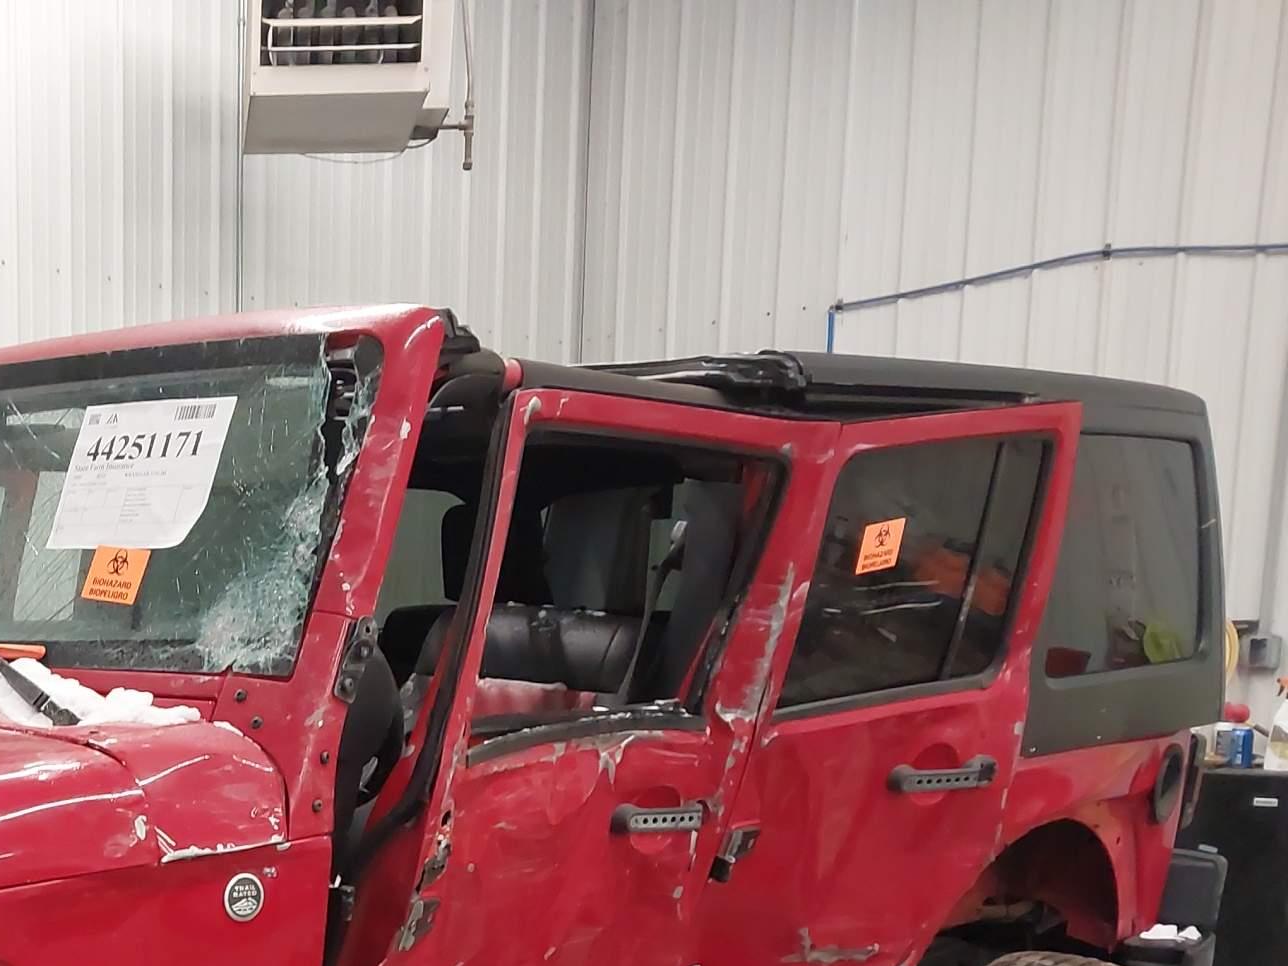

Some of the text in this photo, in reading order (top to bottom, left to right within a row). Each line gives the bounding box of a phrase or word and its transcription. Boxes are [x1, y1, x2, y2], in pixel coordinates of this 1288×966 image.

[87, 430, 204, 462] 44251171
[92, 577, 132, 590] BIOHAZARD
[89, 587, 129, 601] BIOPELIGRO
[232, 890, 258, 898] RATED
[234, 884, 256, 892] TRAIL
